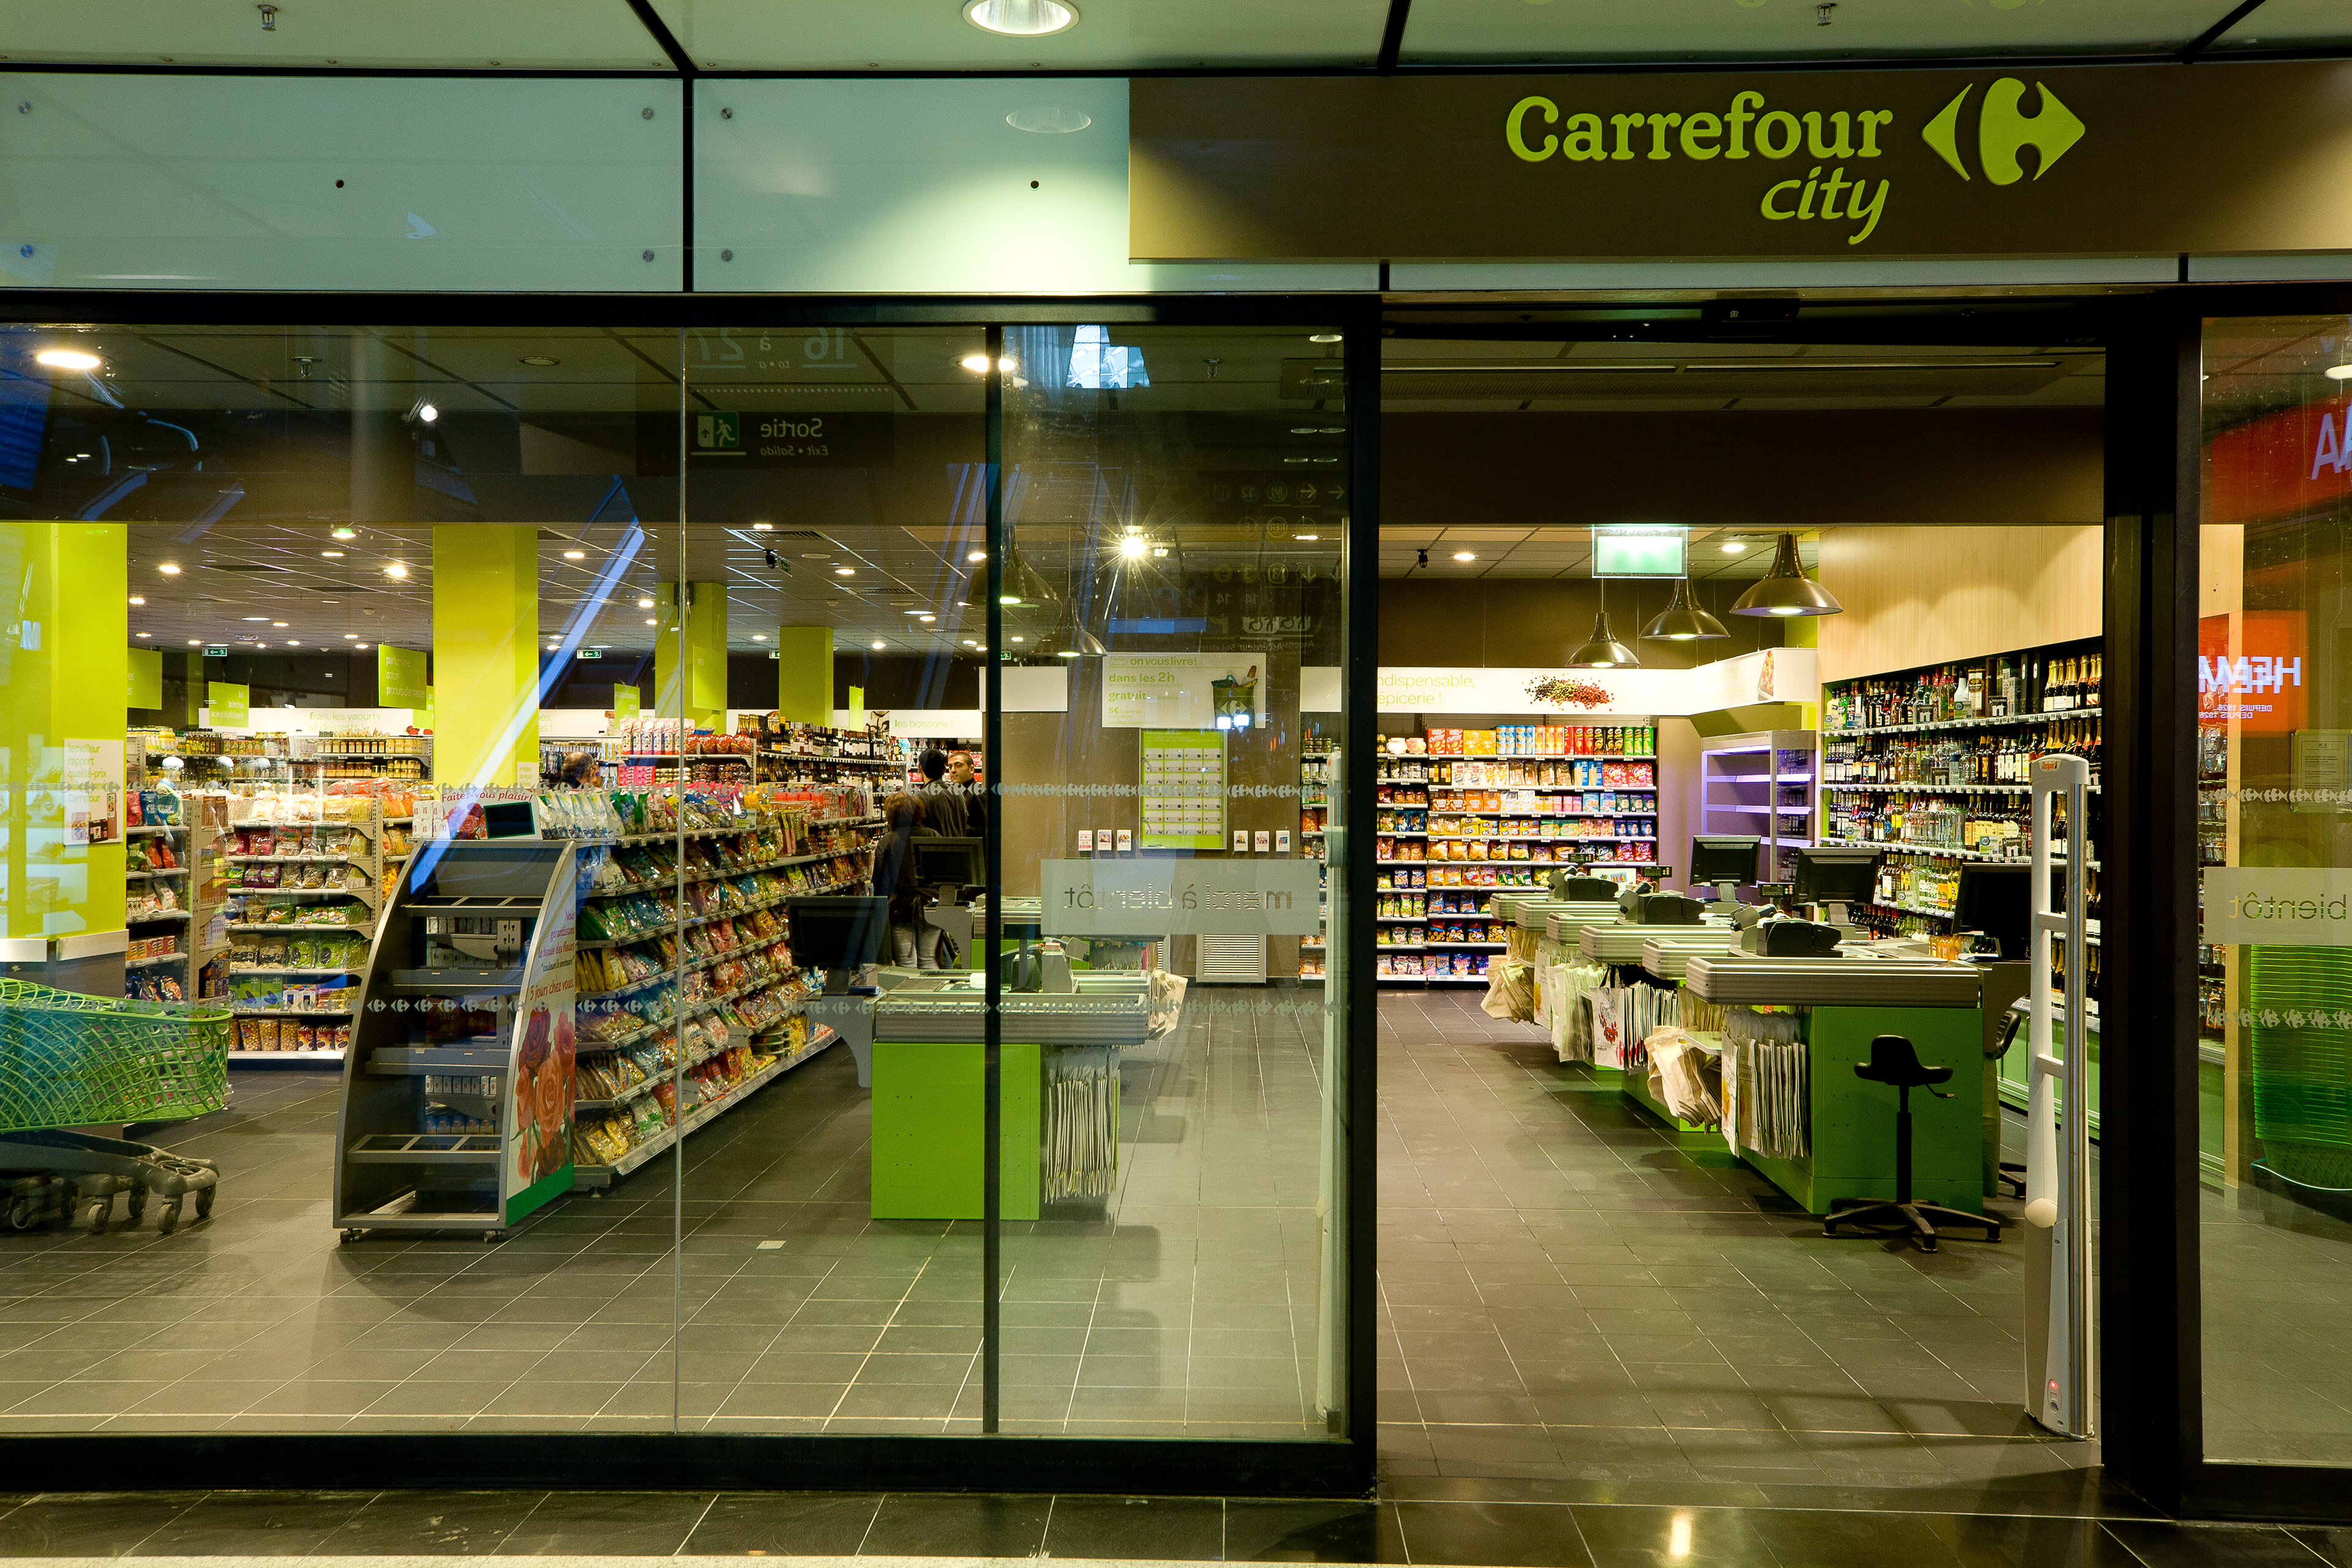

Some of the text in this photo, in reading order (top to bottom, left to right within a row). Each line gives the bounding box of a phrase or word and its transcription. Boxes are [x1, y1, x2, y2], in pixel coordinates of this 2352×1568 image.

[1506, 90, 1893, 162] Carrefour
[1760, 166, 1890, 246] city
[1109, 672, 1175, 682] dans les 2h
[1109, 691, 1147, 703] gratuit
[309, 712, 381, 722] frais, les yaourts
[895, 719, 908, 728] les
[910, 719, 949, 728] boissons
[68, 757, 94, 766] rapport
[68, 768, 107, 780] qualité-prix
[498, 790, 533, 802] plaisir!
[530, 985, 534, 1001] 5
[535, 984, 548, 1001] jours
[549, 979, 561, 995] chez
